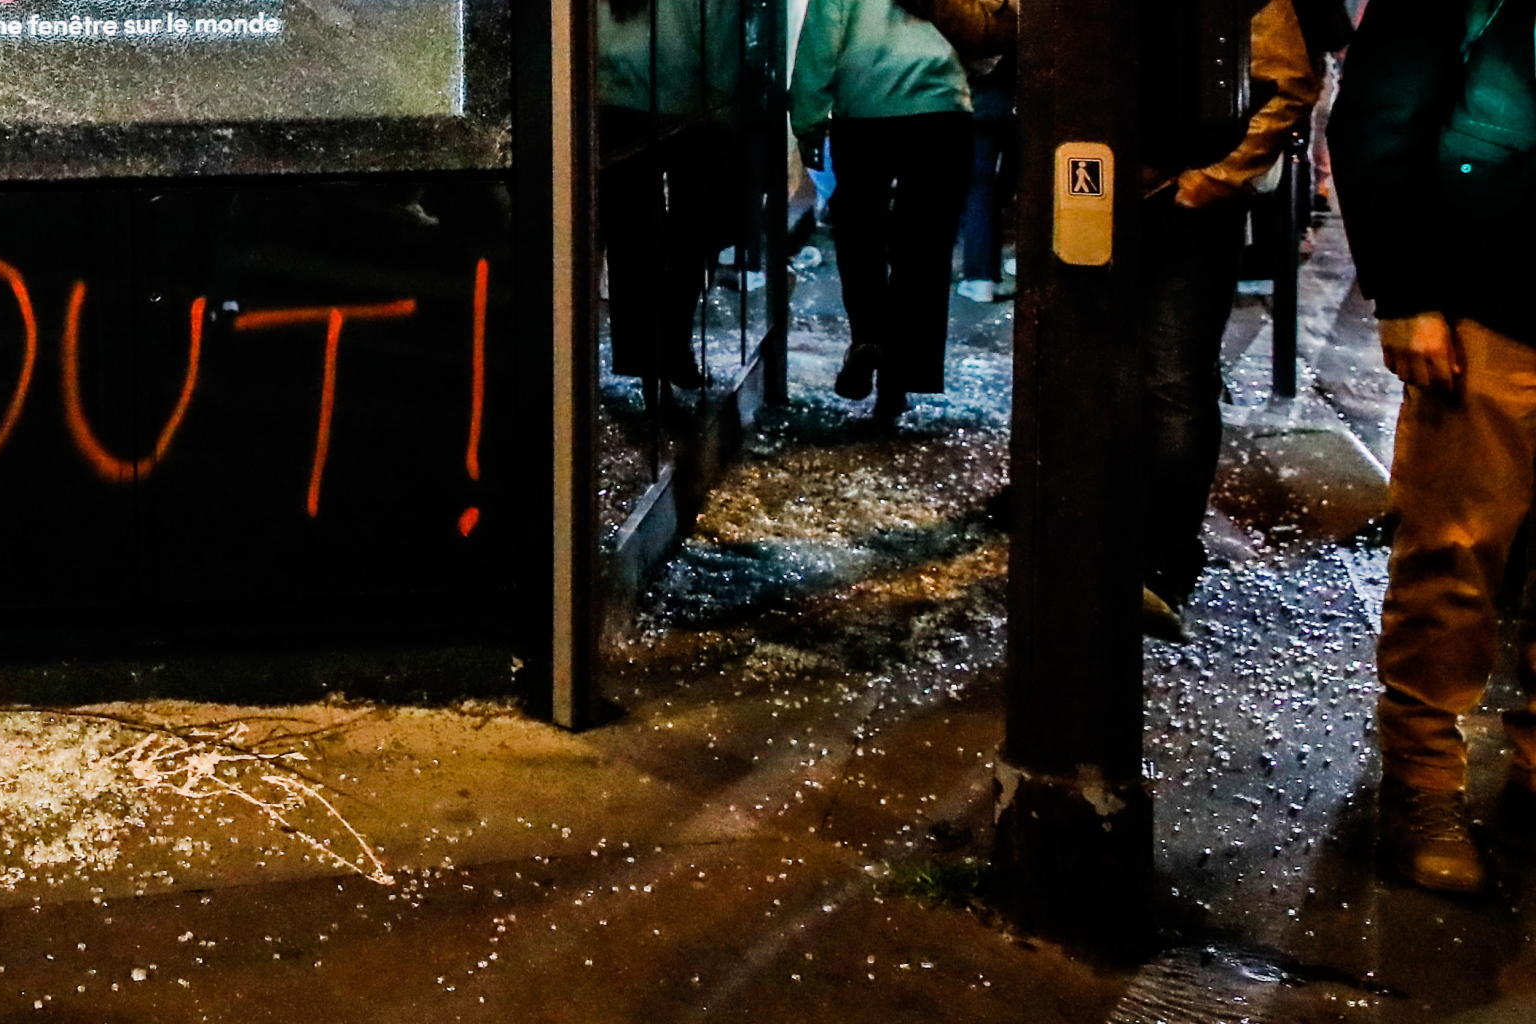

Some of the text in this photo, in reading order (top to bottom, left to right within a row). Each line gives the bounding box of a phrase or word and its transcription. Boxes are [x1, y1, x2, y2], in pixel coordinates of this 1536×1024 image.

[28, 14, 116, 36] fenêtre
[123, 19, 162, 35] sur
[167, 13, 189, 34] le
[195, 12, 281, 34] monde
